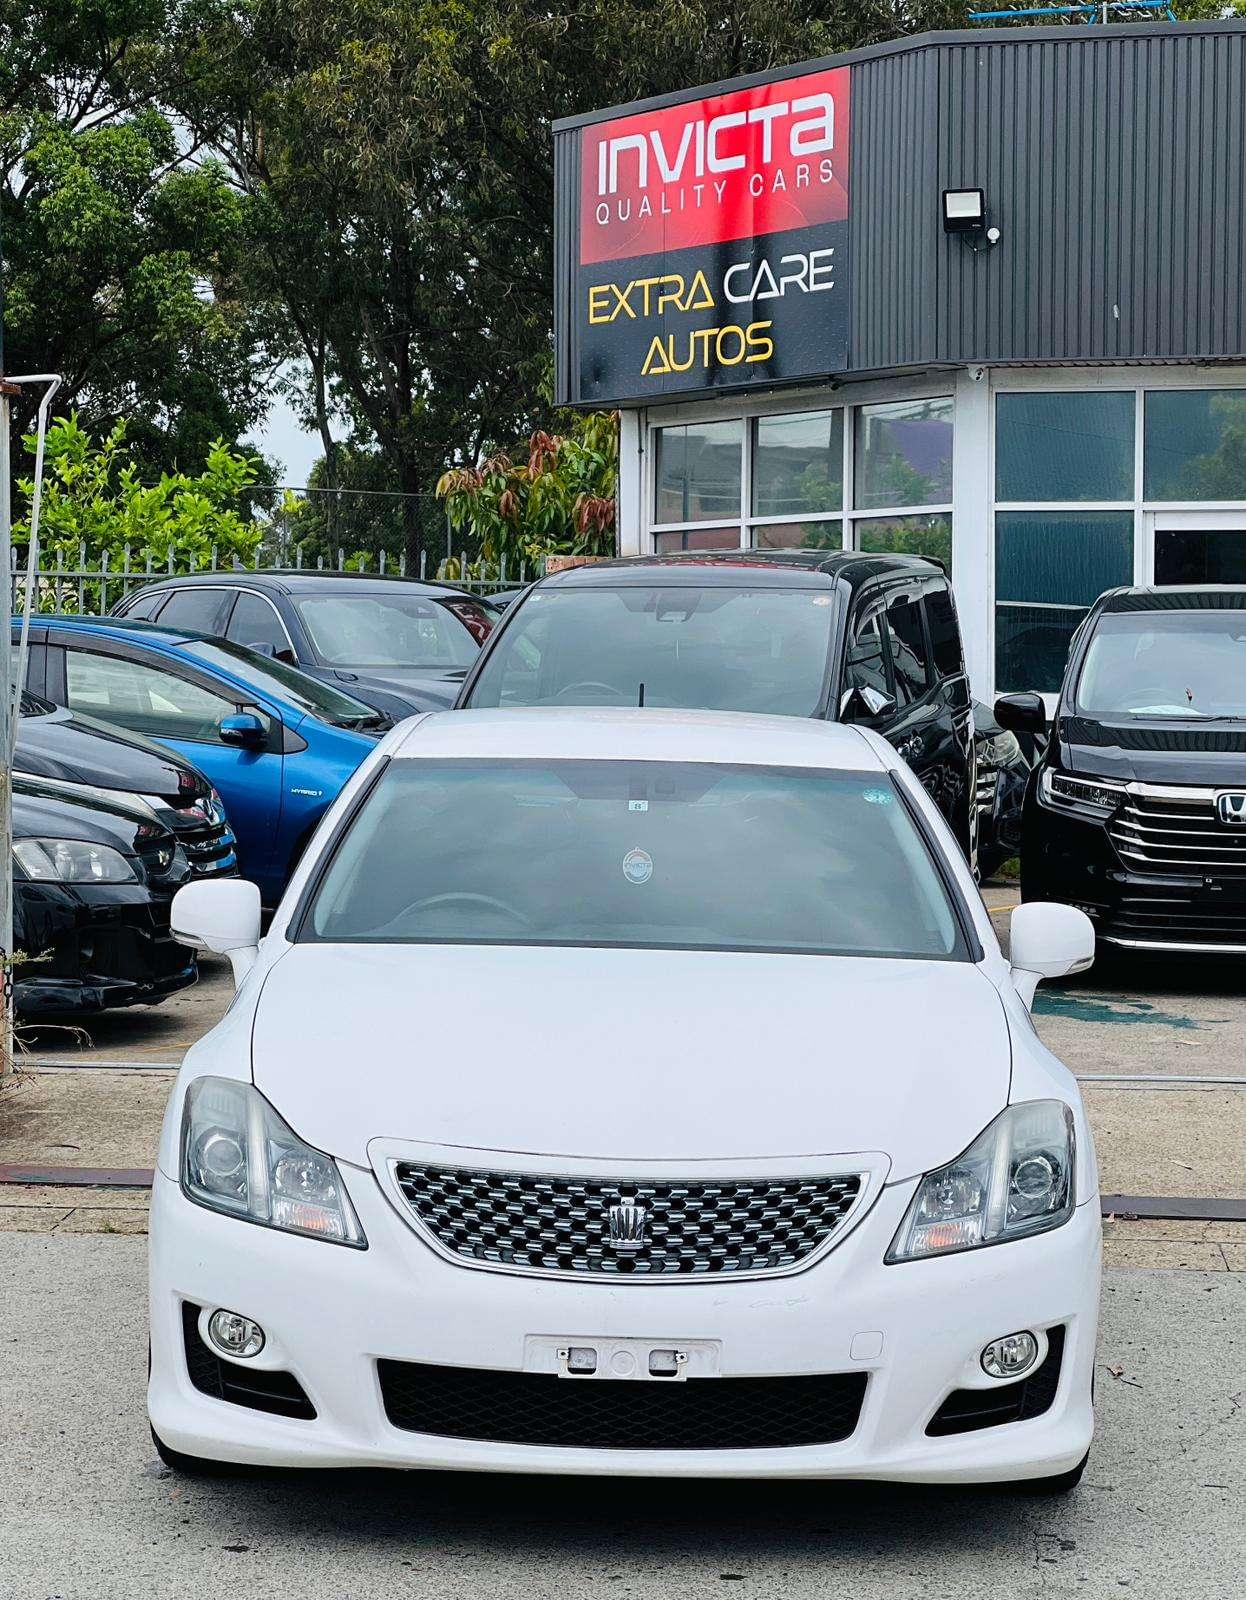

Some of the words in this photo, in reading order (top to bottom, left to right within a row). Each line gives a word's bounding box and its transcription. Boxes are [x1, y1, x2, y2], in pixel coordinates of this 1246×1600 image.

[596, 180, 727, 224] QUALITY
[750, 159, 833, 197] CARS
[589, 270, 715, 324] EXTRA
[724, 248, 835, 303] CARE
[641, 320, 774, 376] AUTOS
